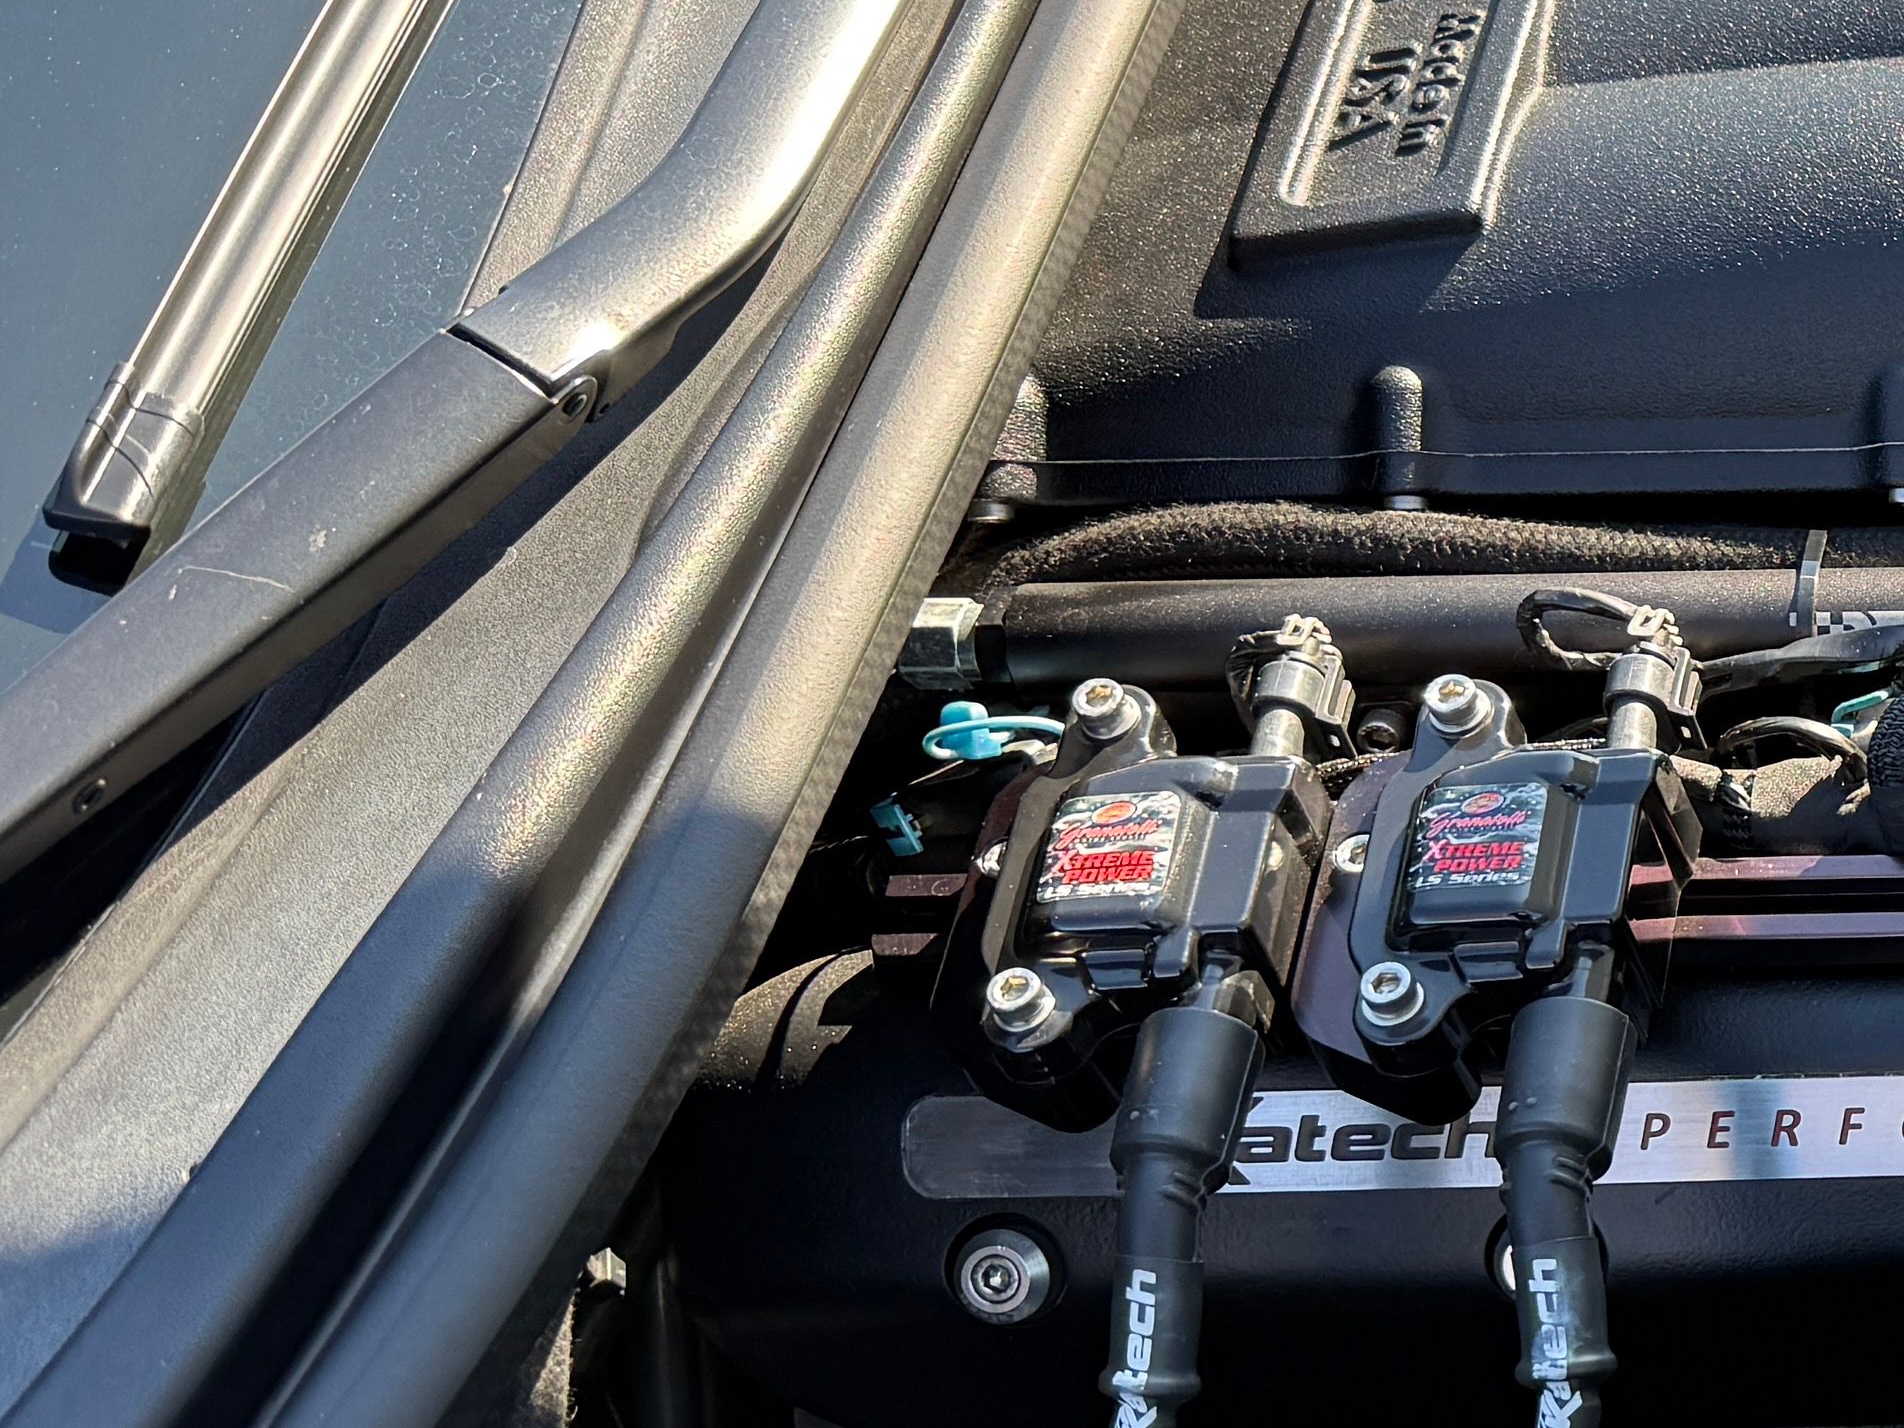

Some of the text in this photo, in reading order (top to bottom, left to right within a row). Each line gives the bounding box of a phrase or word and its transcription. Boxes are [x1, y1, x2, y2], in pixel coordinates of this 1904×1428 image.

[1394, 12, 1486, 157] Made In
[1327, 43, 1423, 152] USA
[1050, 848, 1156, 877] XTREME
[1421, 839, 1526, 870] XTREME
[1433, 856, 1523, 874] POWER
[1063, 865, 1155, 885] POWER
[1414, 871, 1520, 888] LS Series
[1045, 881, 1150, 897] LS Series
